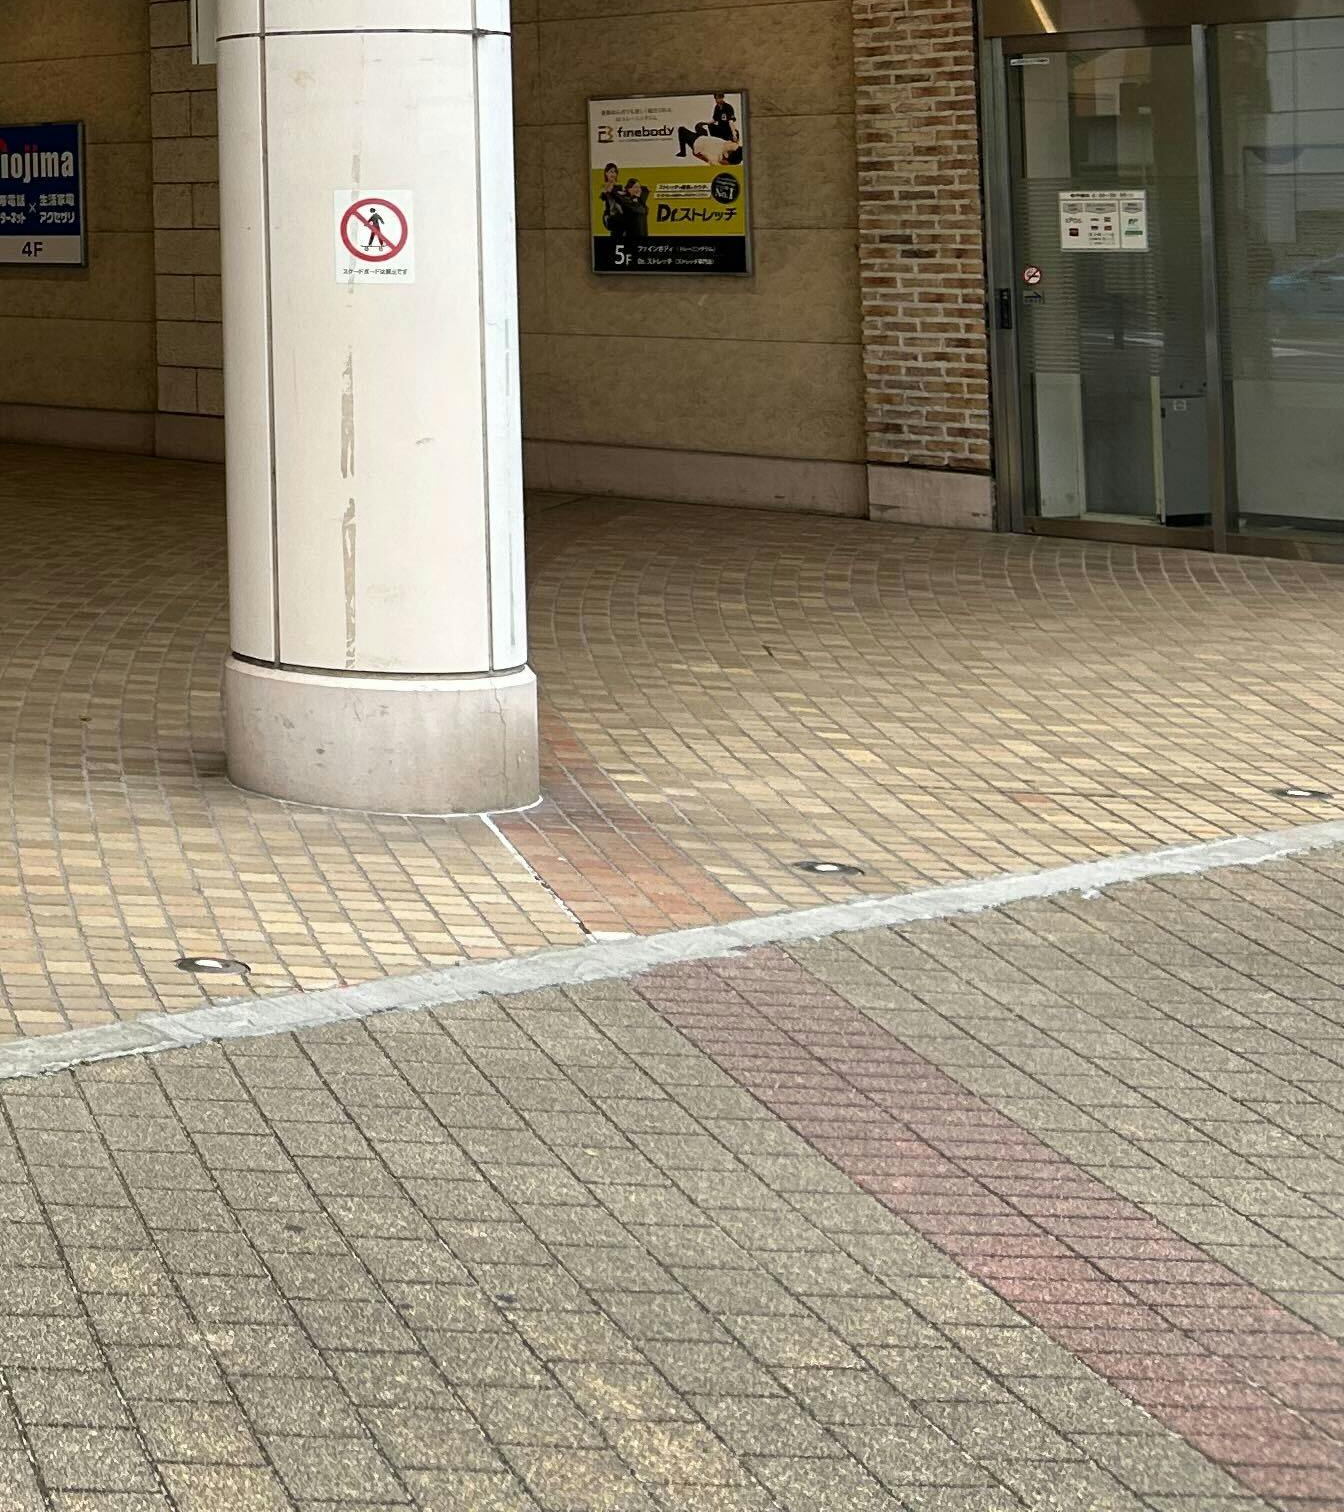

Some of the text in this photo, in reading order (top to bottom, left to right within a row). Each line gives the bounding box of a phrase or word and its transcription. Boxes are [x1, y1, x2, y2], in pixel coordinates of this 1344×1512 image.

[617, 124, 675, 138] finebody
[656, 203, 738, 224] Dr.ストレッチ
[21, 241, 44, 257] 4F
[614, 244, 632, 266] 5F
